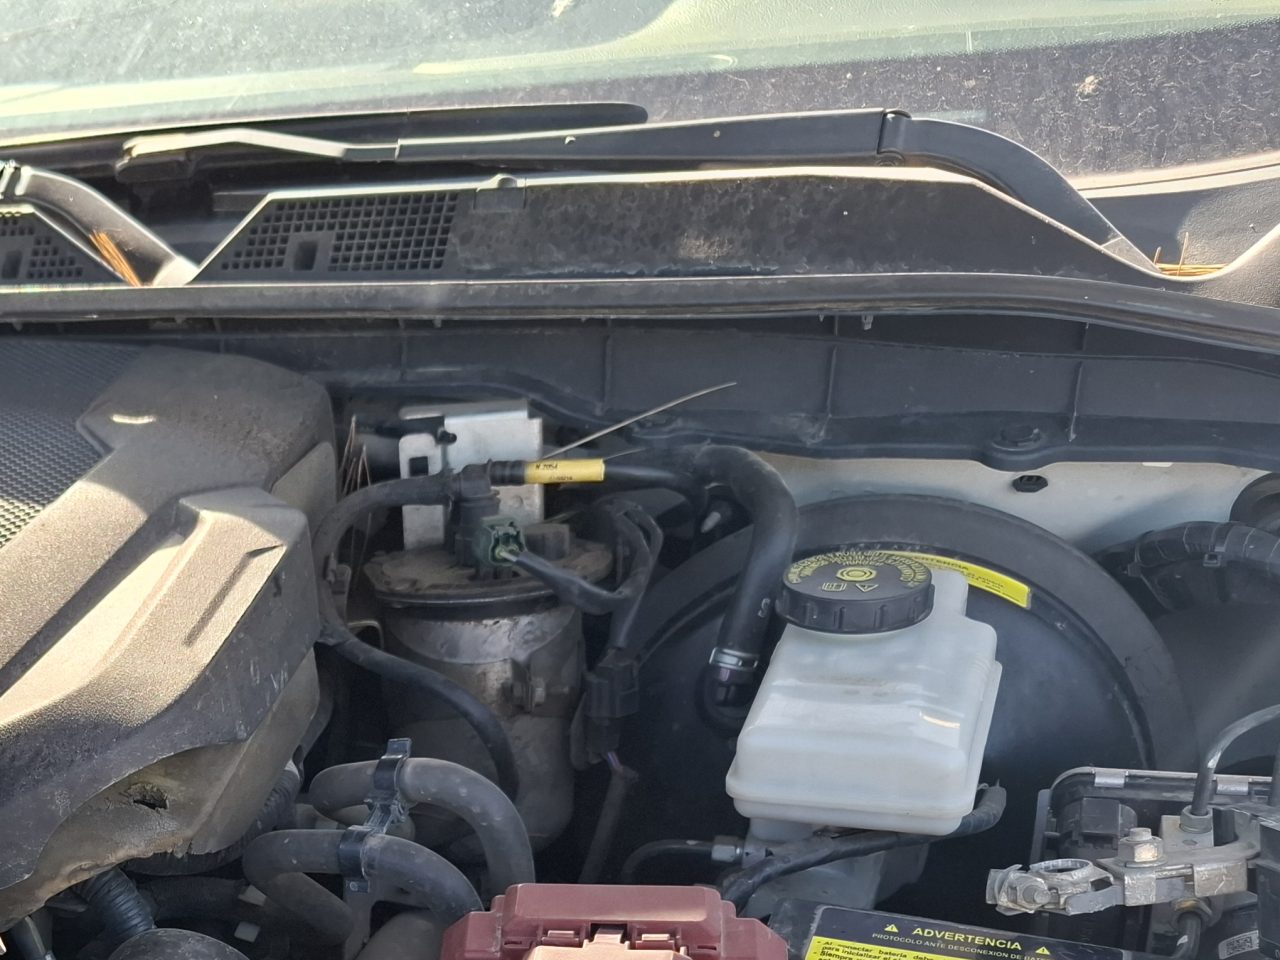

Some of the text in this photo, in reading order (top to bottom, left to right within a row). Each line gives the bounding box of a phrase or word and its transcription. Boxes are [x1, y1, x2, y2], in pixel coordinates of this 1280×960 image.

[871, 932, 922, 945] PROTOCOLO
[923, 940, 945, 948] ANTE
[911, 926, 1022, 950] ADVERTENCIA
[819, 951, 853, 960] Siempre
[841, 948, 881, 959] inicializar
